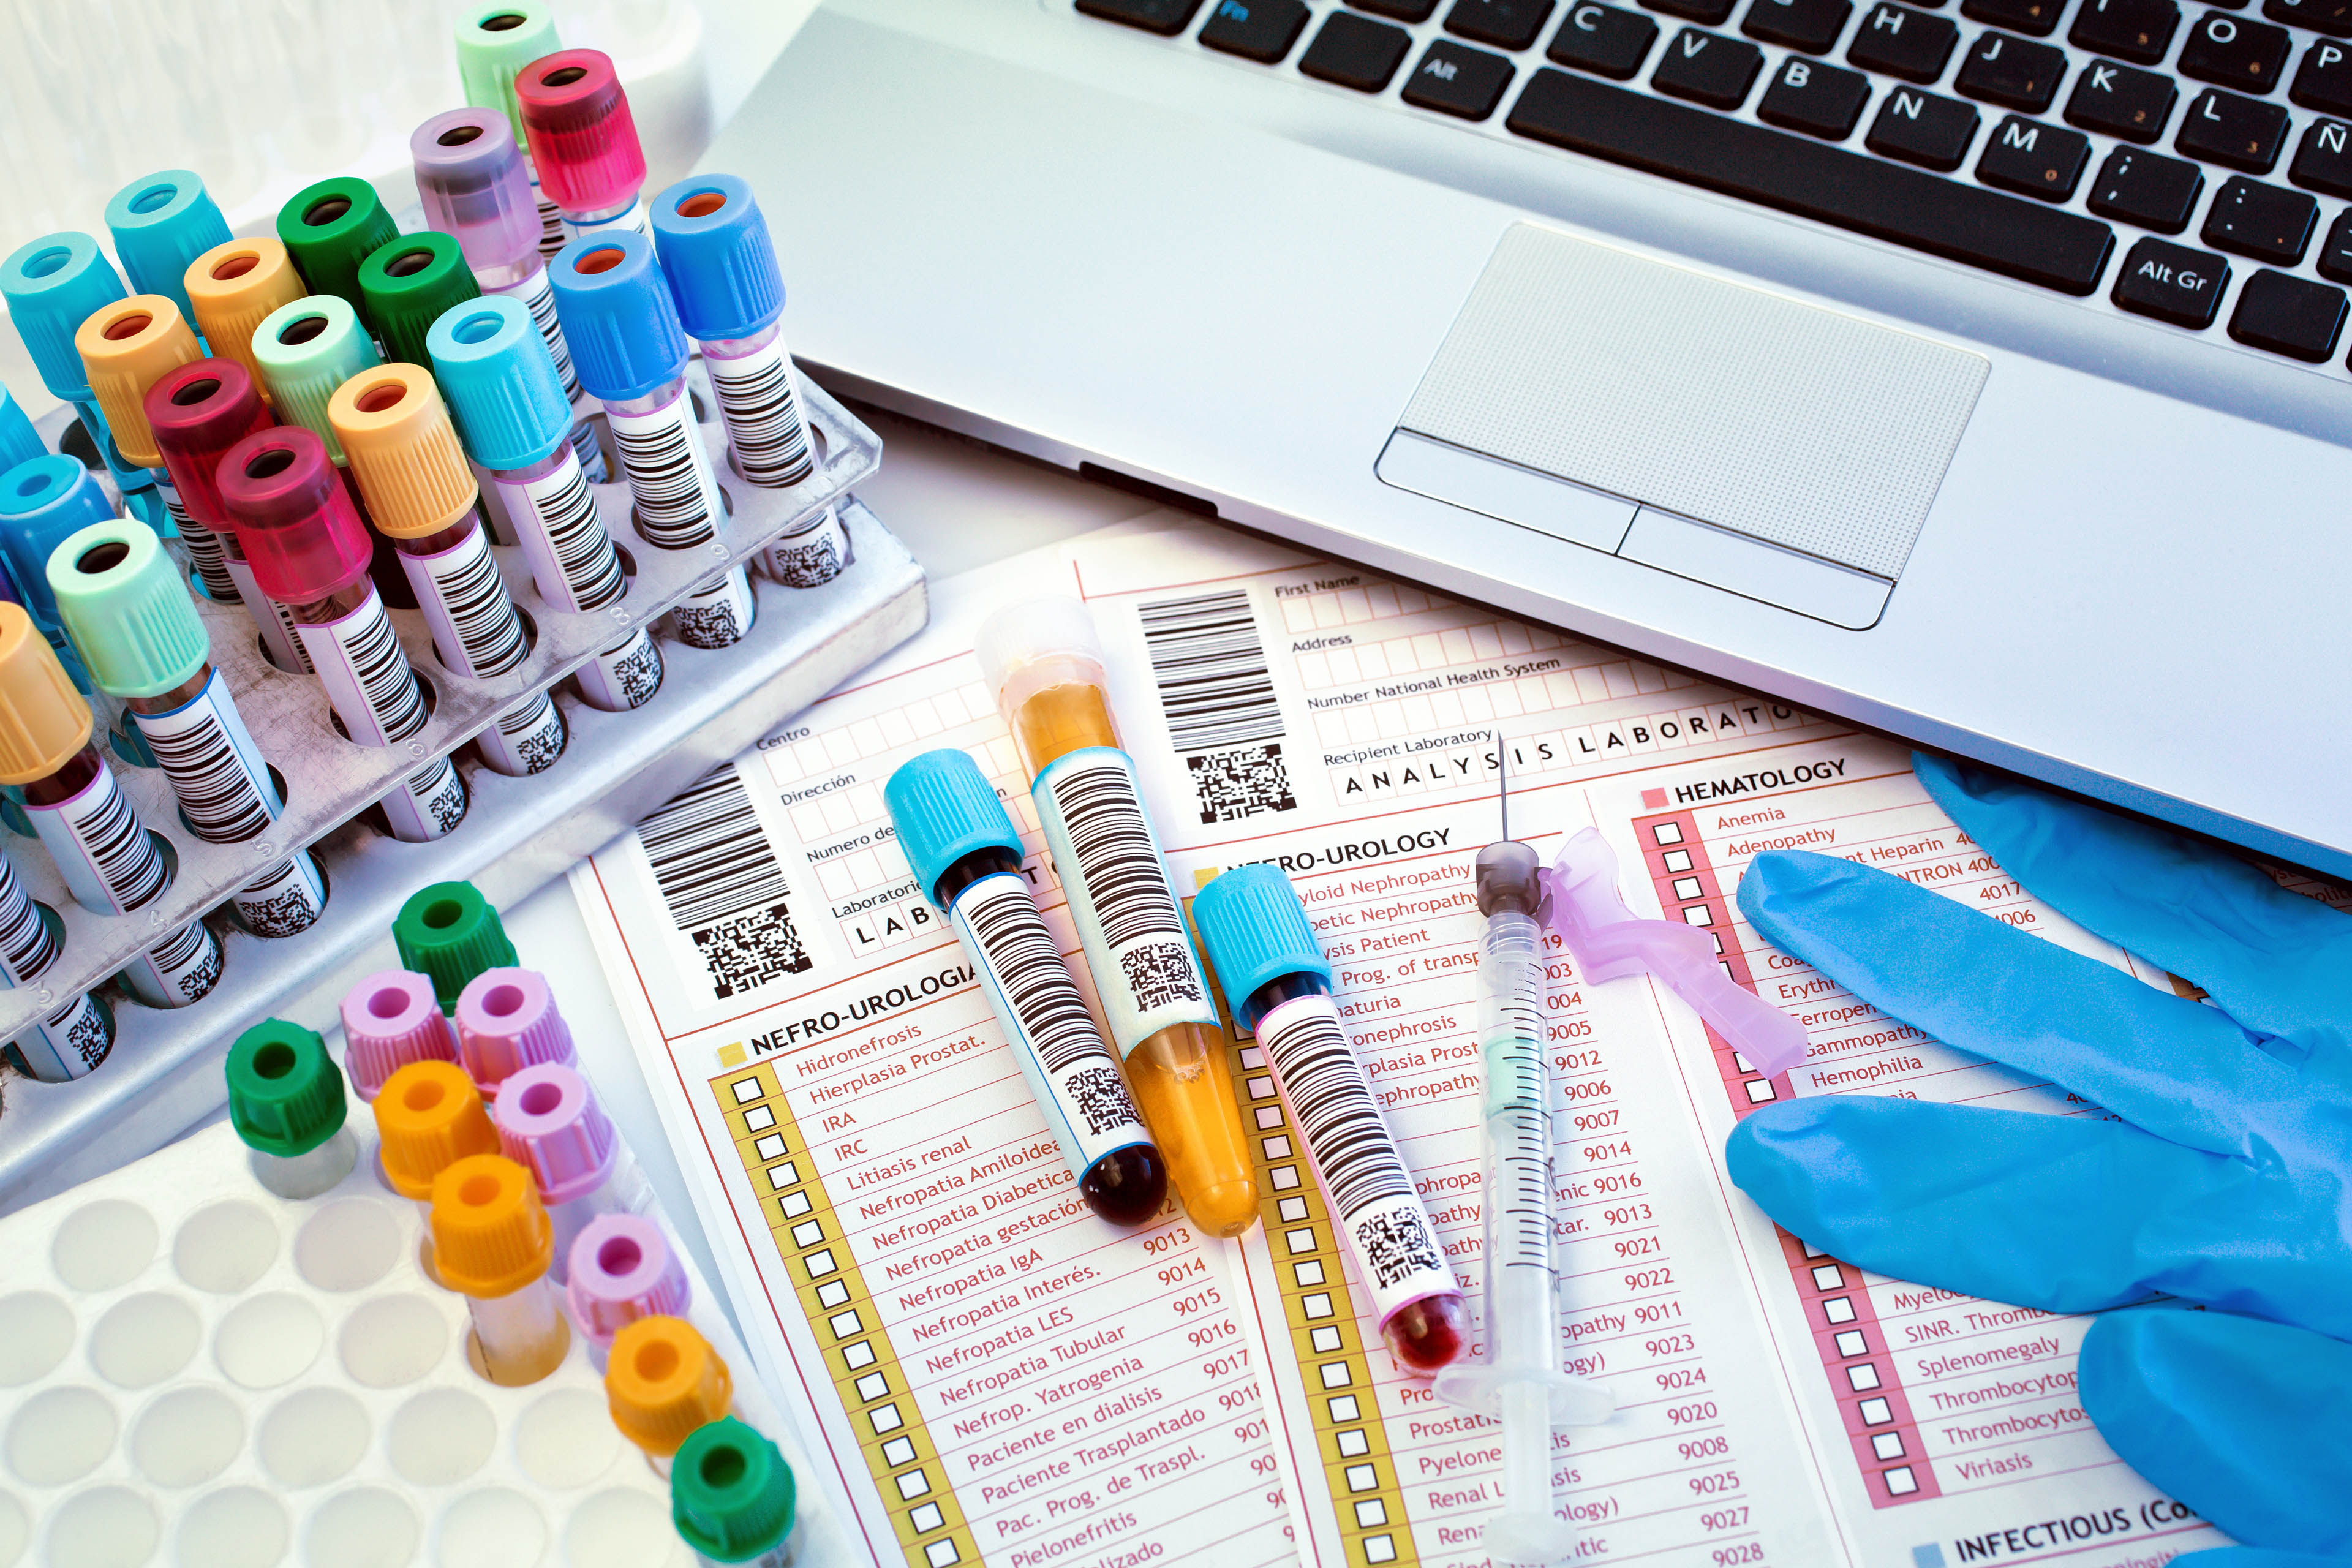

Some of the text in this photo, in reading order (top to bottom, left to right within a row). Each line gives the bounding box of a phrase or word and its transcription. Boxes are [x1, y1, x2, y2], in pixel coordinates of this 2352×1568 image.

[1574, 7, 1604, 31] C
[1874, 7, 1905, 35] H
[2207, 18, 2237, 43] O
[1683, 32, 1709, 58] V
[1981, 38, 2003, 61] J
[2318, 45, 2343, 68] P
[1423, 58, 1458, 81] Alt
[1784, 62, 1811, 87] B
[2091, 65, 2118, 93] K
[1893, 91, 1924, 120] N
[2204, 95, 2221, 121] L
[2003, 123, 2039, 153] M
[2318, 123, 2347, 154] Ñ
[2138, 260, 2207, 292] Alt Gr
[1275, 577, 1359, 597] First Name
[1292, 635, 1352, 652] Address
[1308, 657, 1560, 709] Number National Health System
[756, 725, 810, 752] Centro
[1324, 730, 1491, 766] Recipient Laboratory
[781, 773, 856, 806] Dirección
[1675, 758, 1844, 803] HEMATOLOGY
[1718, 808, 1786, 829] Anemia
[807, 826, 894, 863] Numero de
[1728, 829, 1834, 857] Adenopathy
[1870, 839, 1944, 861] Heparin
[1298, 864, 1470, 907] yloid Nephropathy
[1980, 881, 2021, 900] 4017
[1361, 892, 1478, 922] Nephropathy
[1360, 929, 1430, 952] Patient
[1540, 934, 1562, 950] 19
[1341, 952, 1479, 986] Prog. of transp
[1548, 991, 1582, 1009] 004
[1778, 977, 1836, 999] Erythr
[1353, 1016, 1457, 1046] onephrosis
[796, 1025, 921, 1077] Hidronefrosis
[1362, 1042, 1479, 1079] rplasia Prost
[1555, 1050, 1602, 1071] 9012
[810, 1036, 985, 1104] Hierplasia Prostat.
[1811, 1056, 1923, 1088] Hemophilia
[1375, 1074, 1479, 1110] ephropathy
[1564, 1080, 1611, 1101] 9006
[823, 1112, 856, 1133] IRA
[1574, 1110, 1619, 1131] 9007
[835, 1139, 868, 1161] IRC
[846, 1136, 972, 1190] Litiasis renal
[1584, 1140, 1631, 1162] 9014
[1594, 1172, 1642, 1194] 9016
[859, 1176, 965, 1220] Nefropatia
[872, 1170, 1075, 1250] Nefropatia Diabetica
[1604, 1204, 1652, 1226] 9013
[886, 1196, 1090, 1280] Nefropatia gestación
[1144, 1228, 1190, 1256] 9013
[1615, 1236, 1660, 1257] 9021
[899, 1248, 1043, 1311] Nefropatia IgA
[1158, 1257, 1205, 1286] 9014
[1625, 1268, 1674, 1291] 9022
[913, 1265, 1101, 1342] Nefropatia Interés.
[1173, 1287, 1220, 1316] 9015
[1188, 1319, 1236, 1348] 9016
[1561, 1301, 1681, 1341] opathy 9011
[1905, 1320, 1959, 1343] SINR.
[926, 1307, 1073, 1374] Nefropatia LES
[1646, 1334, 1694, 1357] 9023
[940, 1326, 1125, 1406] Nefropatia Tubular
[1204, 1349, 1247, 1379] 9017
[1918, 1336, 2059, 1379] Splenomegaly
[1656, 1367, 1706, 1390] 9024
[1929, 1371, 2076, 1410] Thrombocytop
[954, 1358, 1144, 1438] Nefrop. Yatrogenia
[1667, 1401, 1717, 1425] 9020
[1942, 1408, 2089, 1444] Thrombocytos
[968, 1387, 1162, 1471] Paciente en dialisis
[1235, 1418, 1269, 1443] 901
[982, 1409, 1205, 1504] Paciente Trasplantado
[1419, 1436, 1728, 1476] Pyelone 9008
[1955, 1453, 2032, 1480] Viriasis
[996, 1446, 1205, 1537] Pac. Prog. de Traspl.
[1428, 1483, 1488, 1509] Renal
[1689, 1471, 1740, 1495] 9025
[1701, 1506, 1749, 1531] 9027
[1955, 1507, 2132, 1562] INFECTIOUS
[2140, 1499, 2195, 1529] (Co
[1011, 1513, 1137, 1568] Pielonefritis
[1713, 1543, 1763, 1567] 9028
